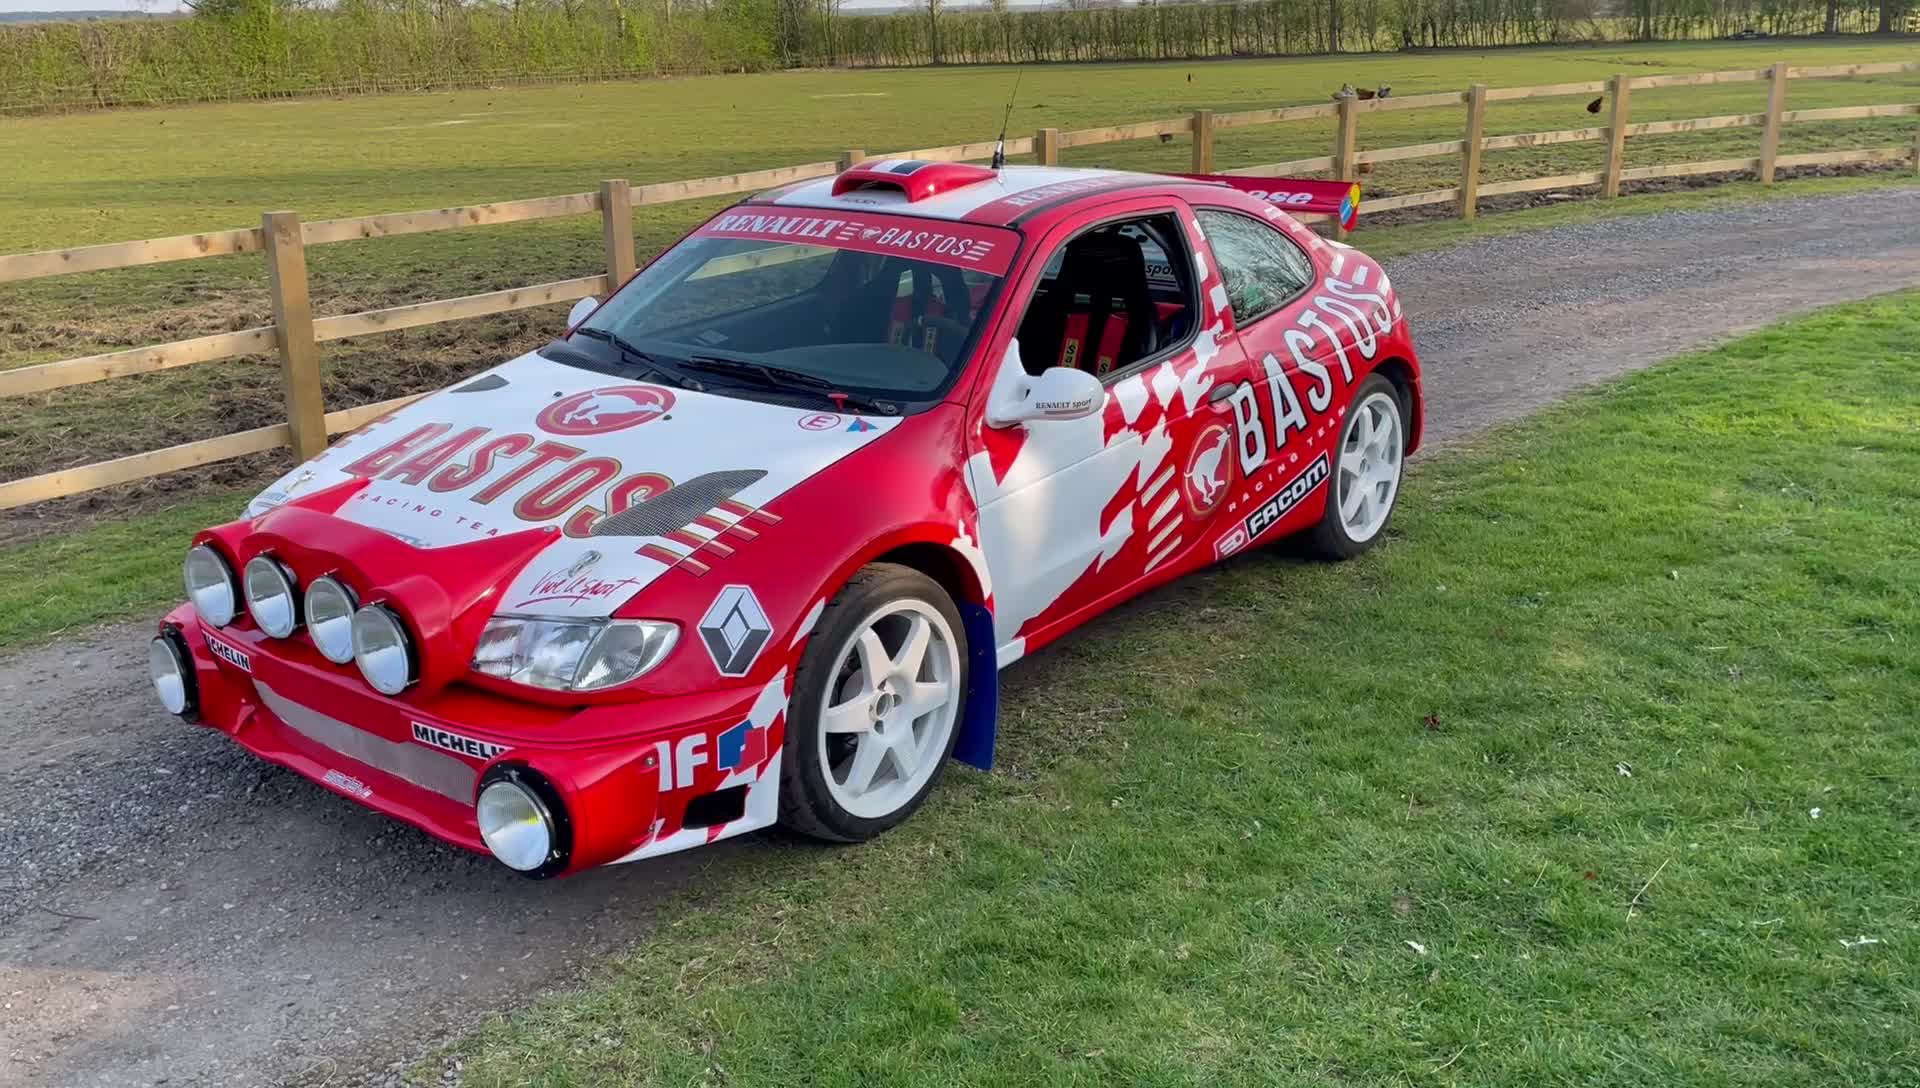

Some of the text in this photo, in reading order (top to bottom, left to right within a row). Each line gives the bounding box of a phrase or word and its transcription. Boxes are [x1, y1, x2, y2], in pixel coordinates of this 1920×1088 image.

[711, 215, 973, 257] RENAULT BASTOS
[1145, 264, 1175, 276] spo
[1230, 277, 1393, 480] BASTOS
[1072, 398, 1092, 408] sport
[1228, 404, 1346, 513] RACING TEAM
[340, 422, 676, 539] BASTOS
[1249, 459, 1328, 536] FACOM
[357, 493, 498, 536] RACING TEA
[204, 632, 250, 671] ICHELIN
[413, 723, 506, 760] MICHELI
